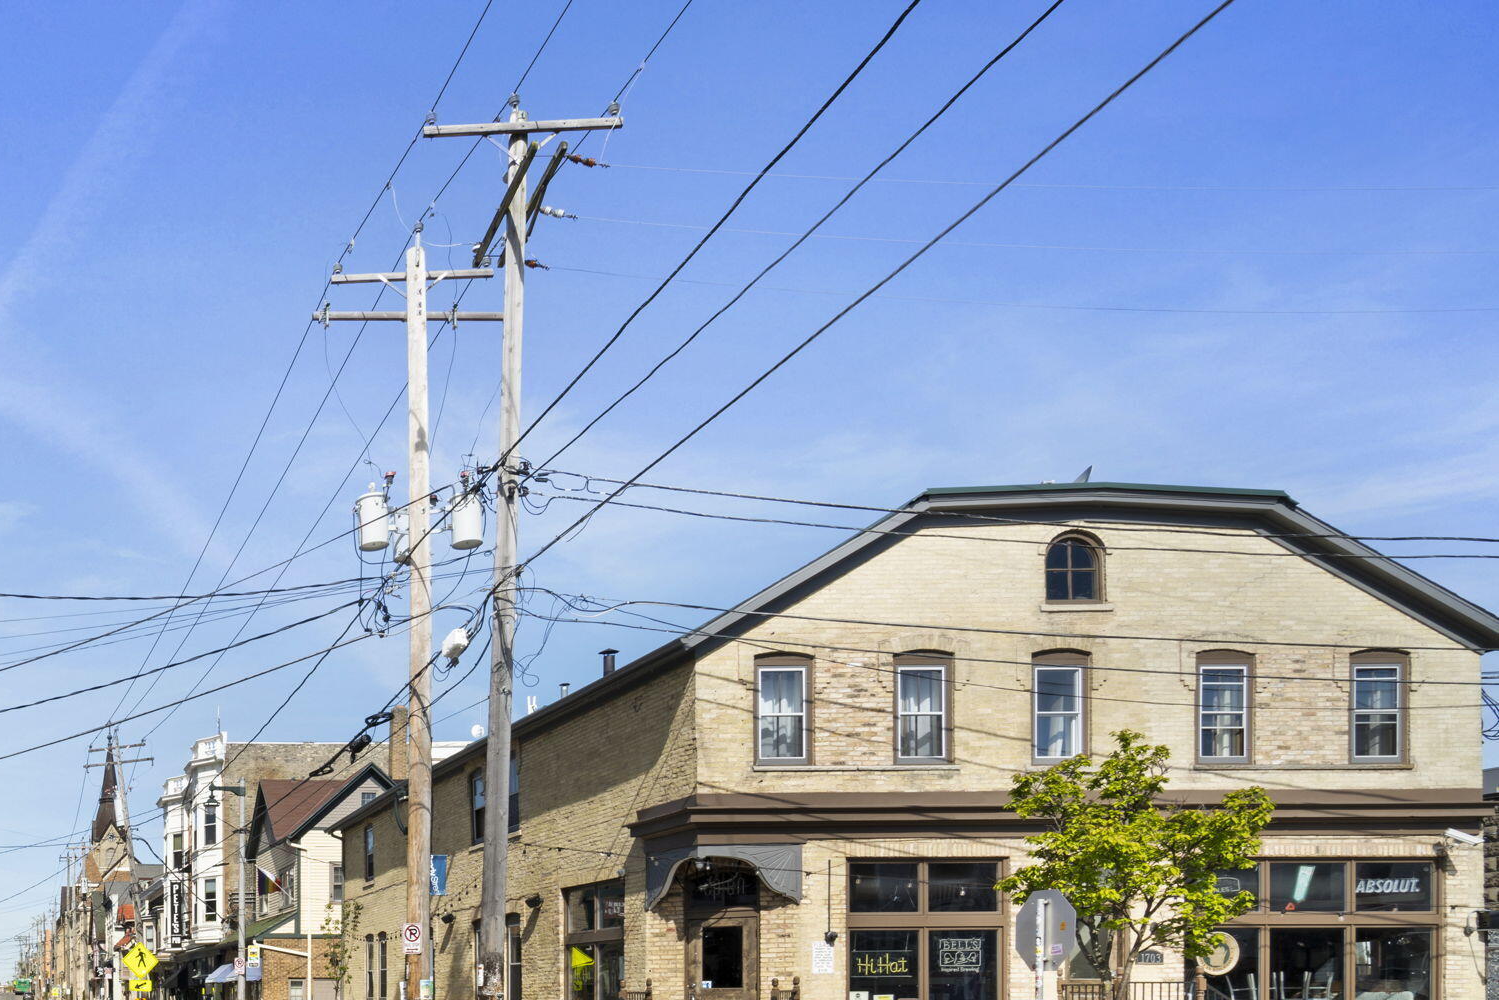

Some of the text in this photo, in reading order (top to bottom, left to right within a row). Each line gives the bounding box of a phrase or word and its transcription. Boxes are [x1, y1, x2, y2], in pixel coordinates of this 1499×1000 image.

[172, 884, 180, 933] PETE'S
[943, 940, 980, 950] BELL'S
[1141, 953, 1161, 963] 1703
